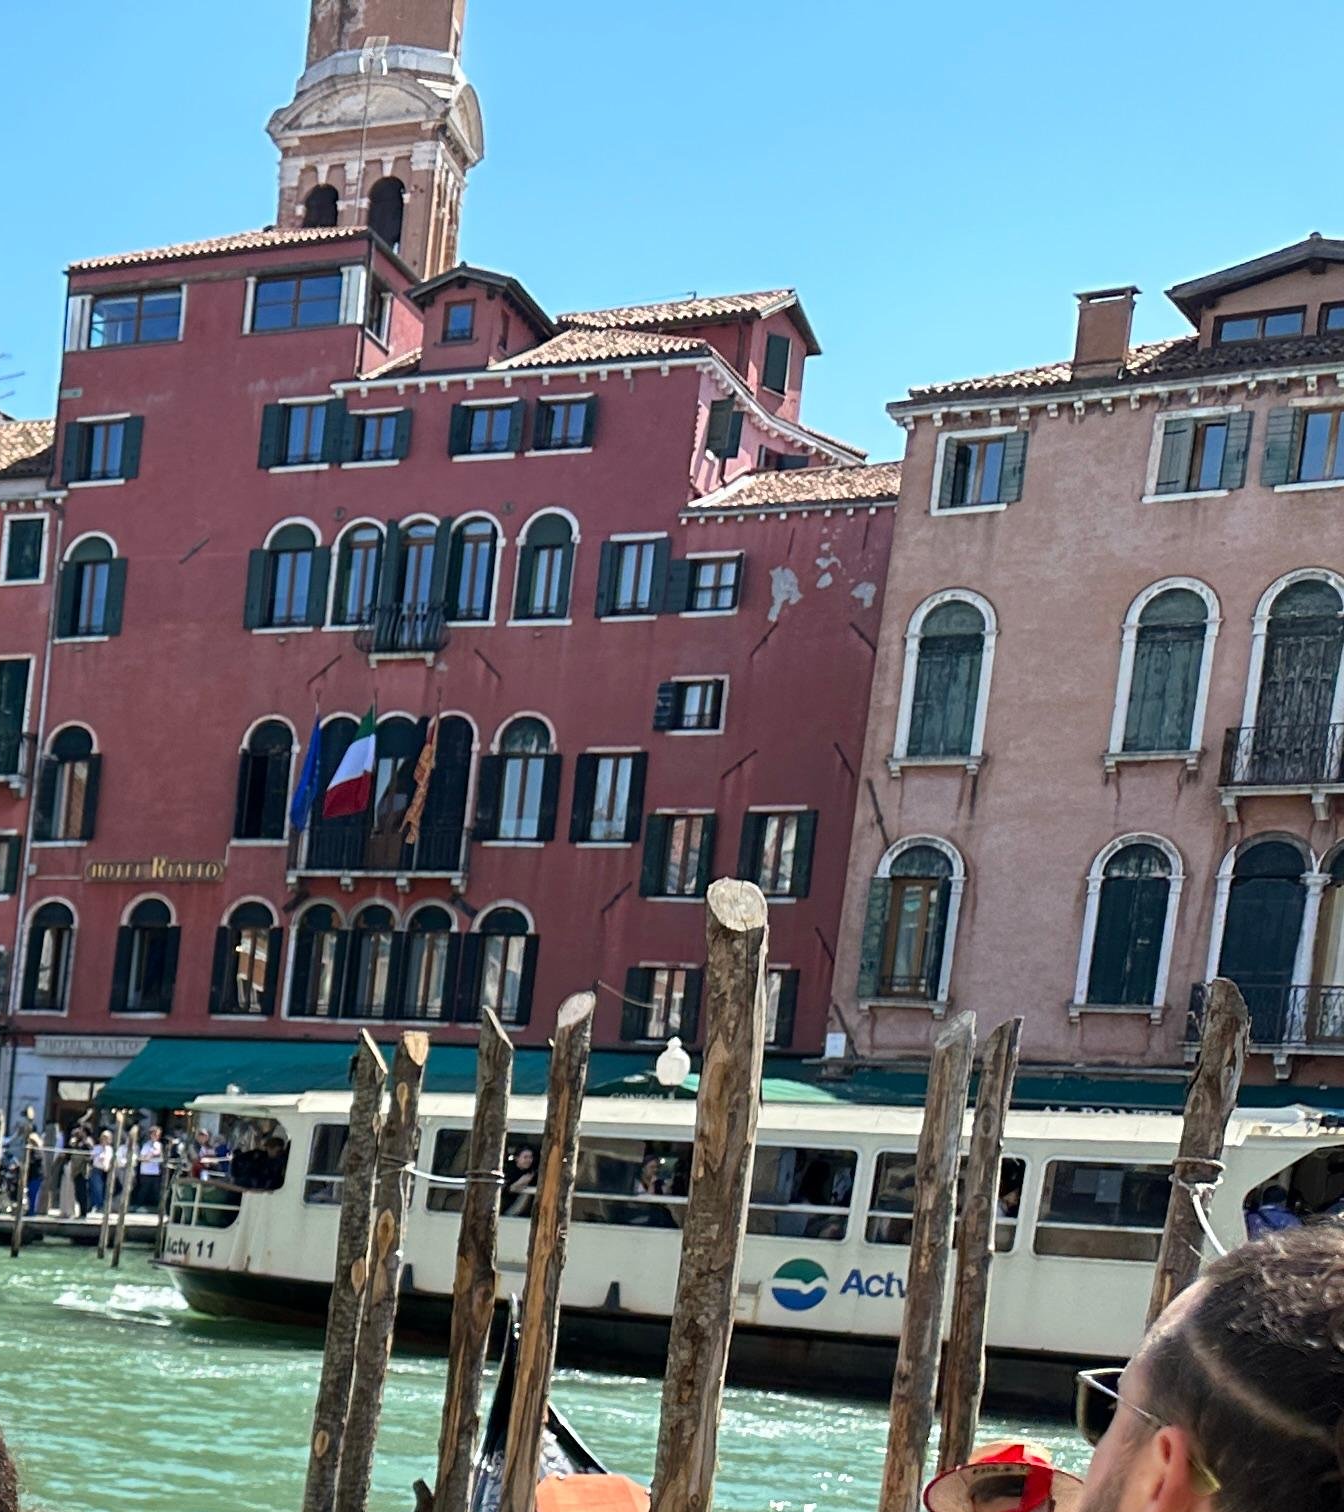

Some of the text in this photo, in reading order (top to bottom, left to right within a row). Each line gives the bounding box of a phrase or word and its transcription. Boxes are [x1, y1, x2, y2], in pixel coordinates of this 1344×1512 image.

[91, 856, 219, 879] HOTEL RIALTO
[43, 1039, 83, 1051] HOTEL
[196, 1239, 214, 1259] 11
